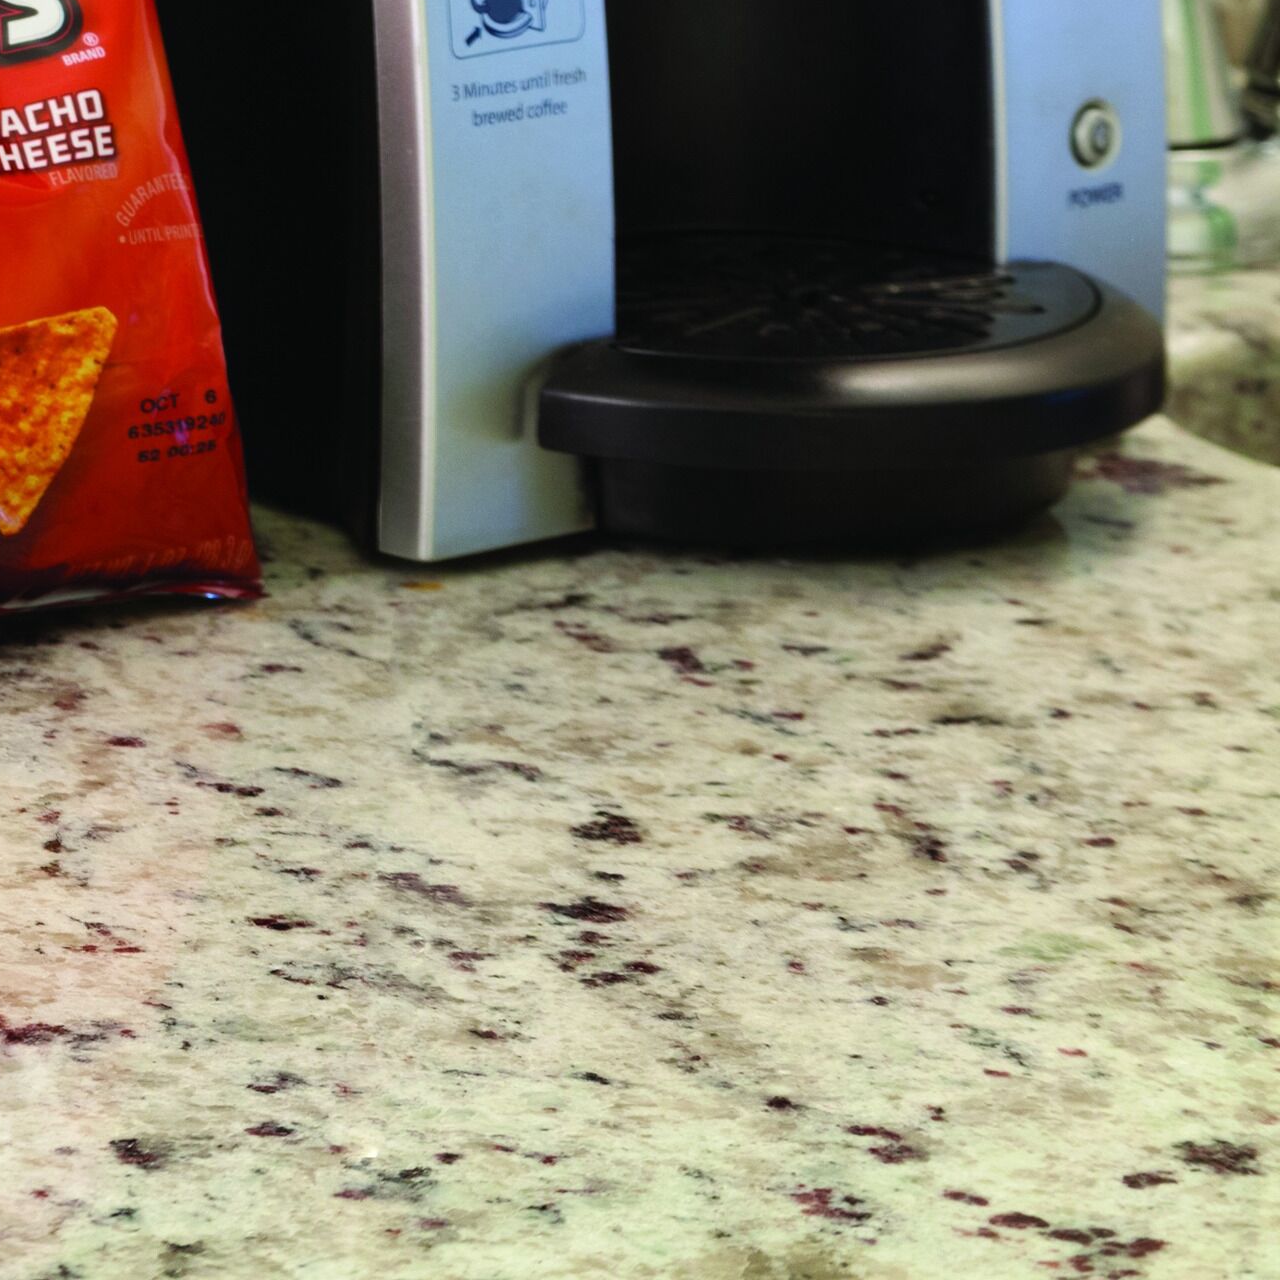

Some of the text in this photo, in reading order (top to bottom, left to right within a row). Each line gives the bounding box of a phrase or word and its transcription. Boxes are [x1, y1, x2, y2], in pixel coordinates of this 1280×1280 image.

[61, 46, 107, 67] BRAND
[451, 67, 588, 102] 3 Minutes until fresh
[471, 98, 569, 127] brewed coffee
[48, 162, 119, 187] FLAVORED
[140, 393, 179, 414] OCT
